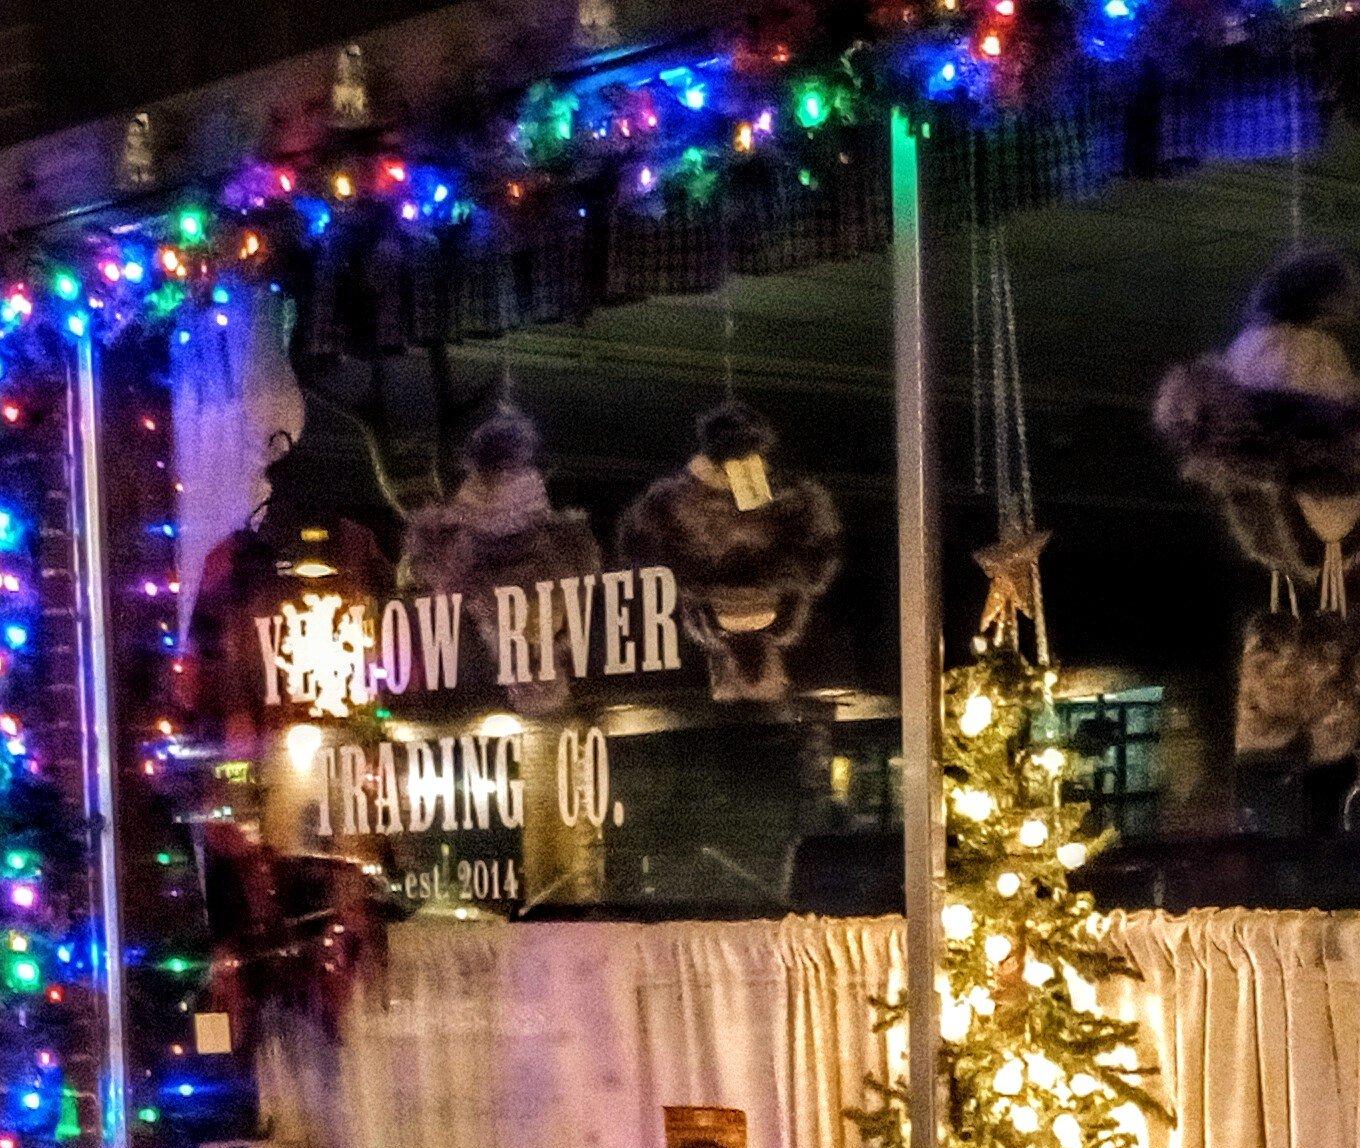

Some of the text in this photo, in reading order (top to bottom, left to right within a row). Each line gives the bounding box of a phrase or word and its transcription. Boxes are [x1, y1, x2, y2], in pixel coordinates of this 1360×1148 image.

[254, 566, 682, 706] YELOW RIVER
[312, 726, 625, 837] TRADING CO.
[457, 859, 519, 900] 2014
